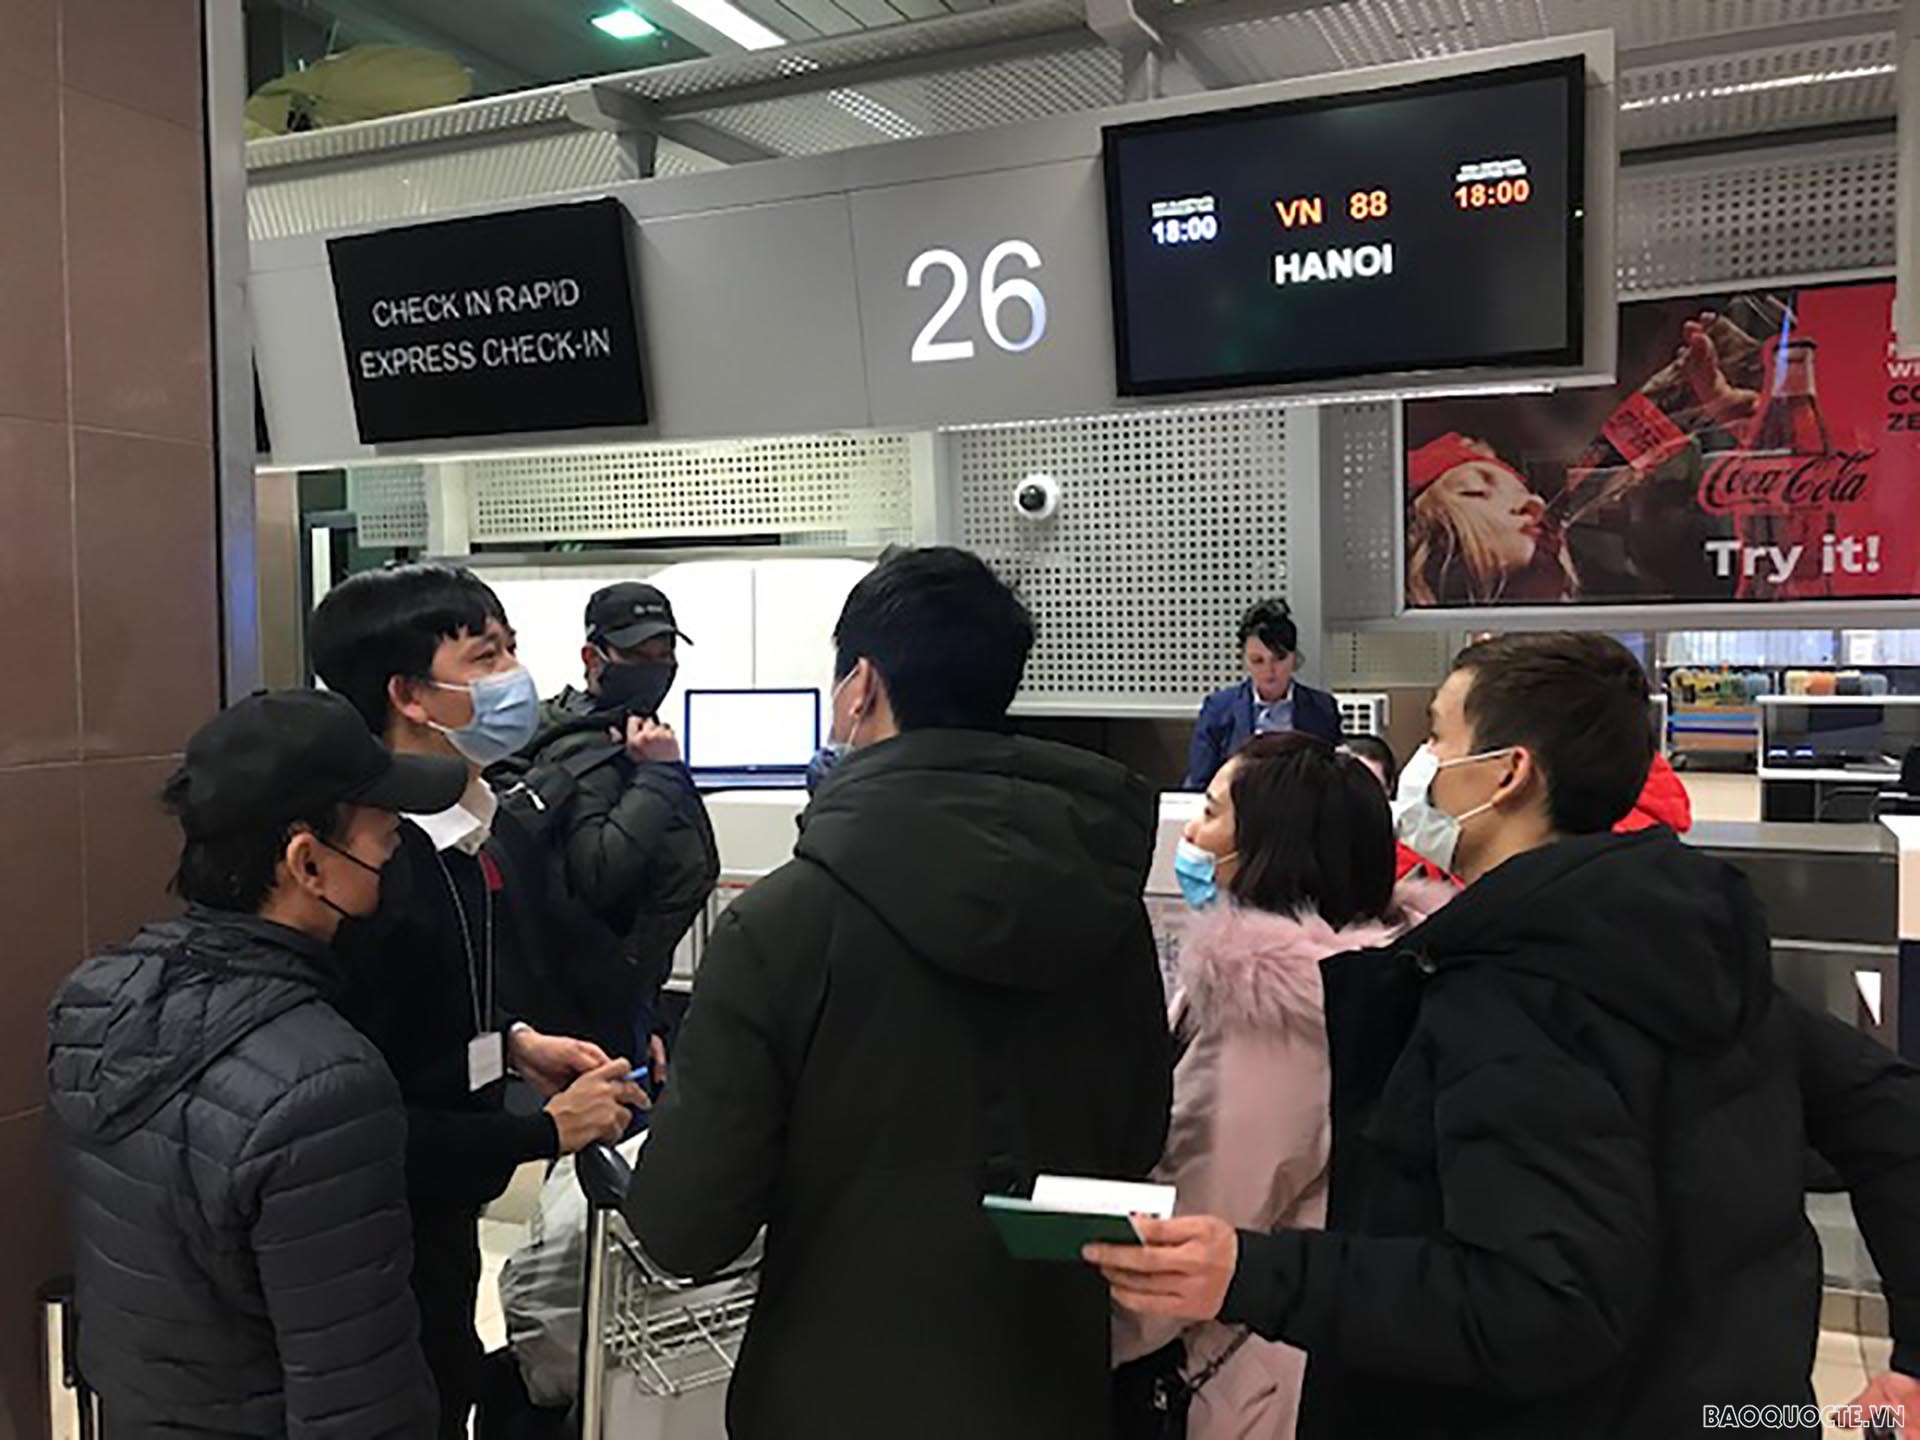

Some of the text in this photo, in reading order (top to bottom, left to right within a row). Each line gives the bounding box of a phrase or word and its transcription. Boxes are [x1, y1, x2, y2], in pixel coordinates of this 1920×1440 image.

[1275, 190, 1388, 228] VN 88
[1454, 179, 1530, 209] 18:00
[1151, 214, 1217, 244] 18:00
[1275, 242, 1393, 285] HANOI
[371, 278, 580, 327] CHECK IN RAPID
[906, 239, 1047, 363] 26
[359, 326, 612, 379] EXPRESS CHECK-IN
[1704, 532, 1881, 584] Try it!
